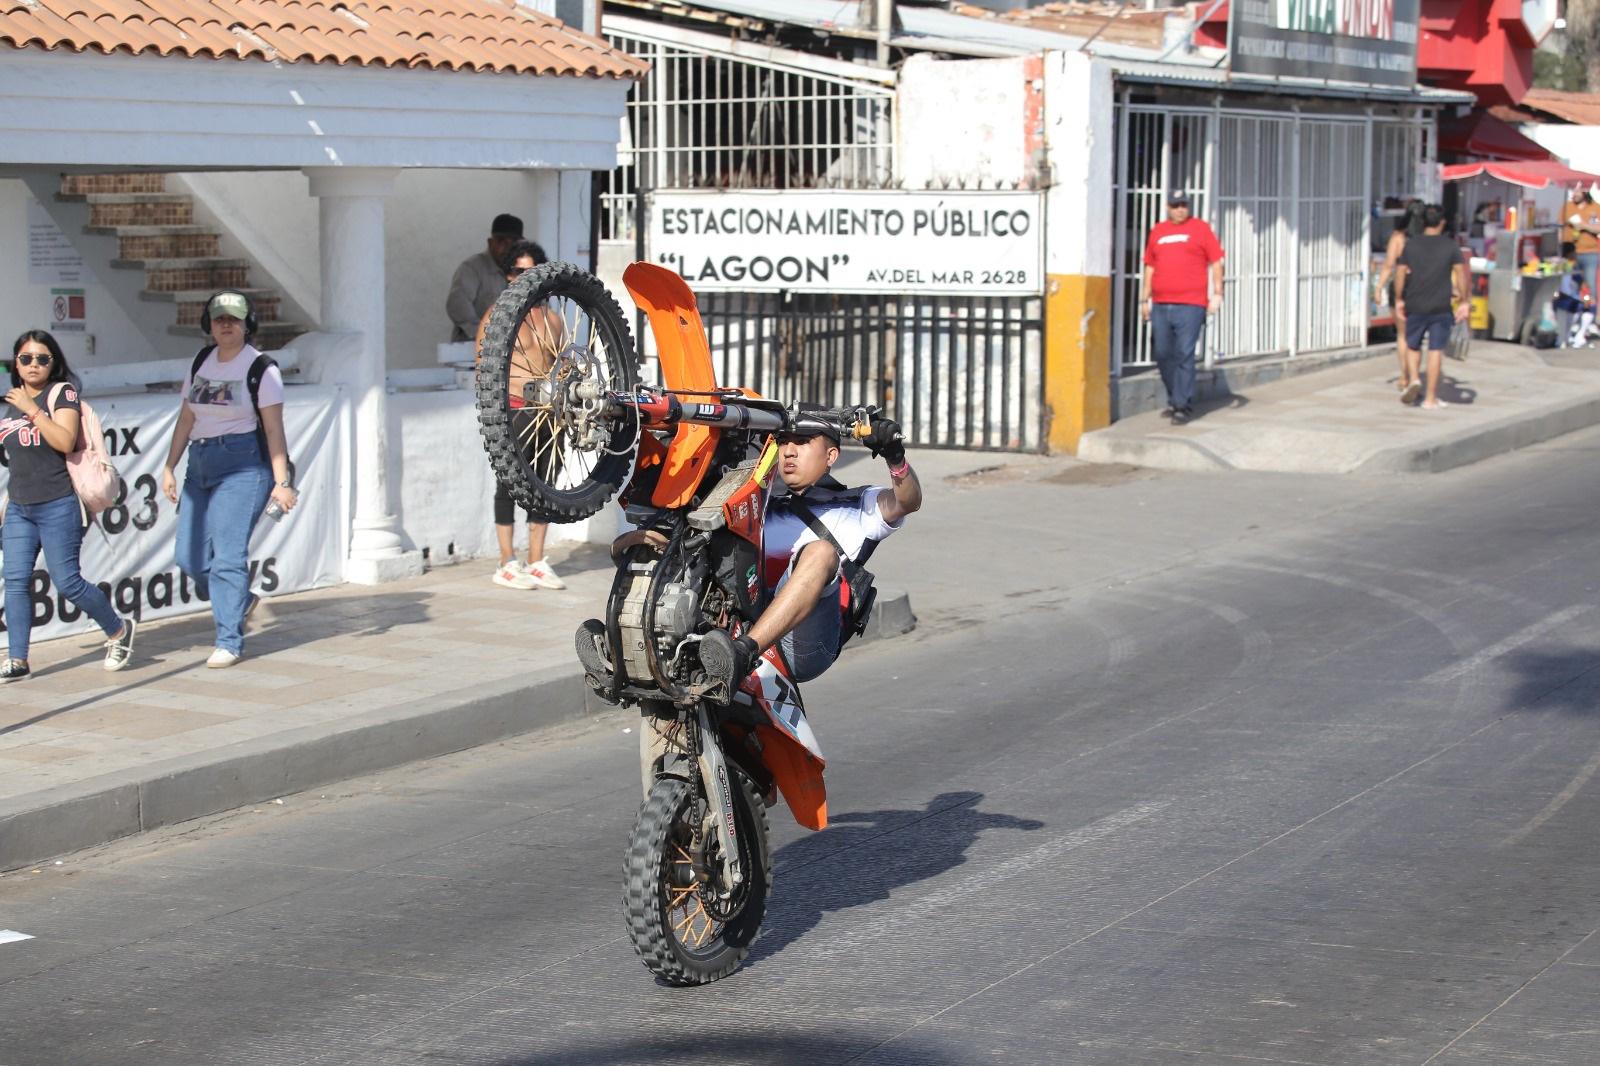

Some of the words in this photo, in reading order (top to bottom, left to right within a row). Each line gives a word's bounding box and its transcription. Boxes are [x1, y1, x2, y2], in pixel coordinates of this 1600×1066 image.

[662, 208, 904, 236] ESTACIONAMIENTO
[913, 200, 1030, 237] PÚBLICO
[932, 271, 974, 284] MAR
[981, 270, 1026, 284] 2628
[699, 404, 724, 415] WP
[18, 426, 41, 447] 01
